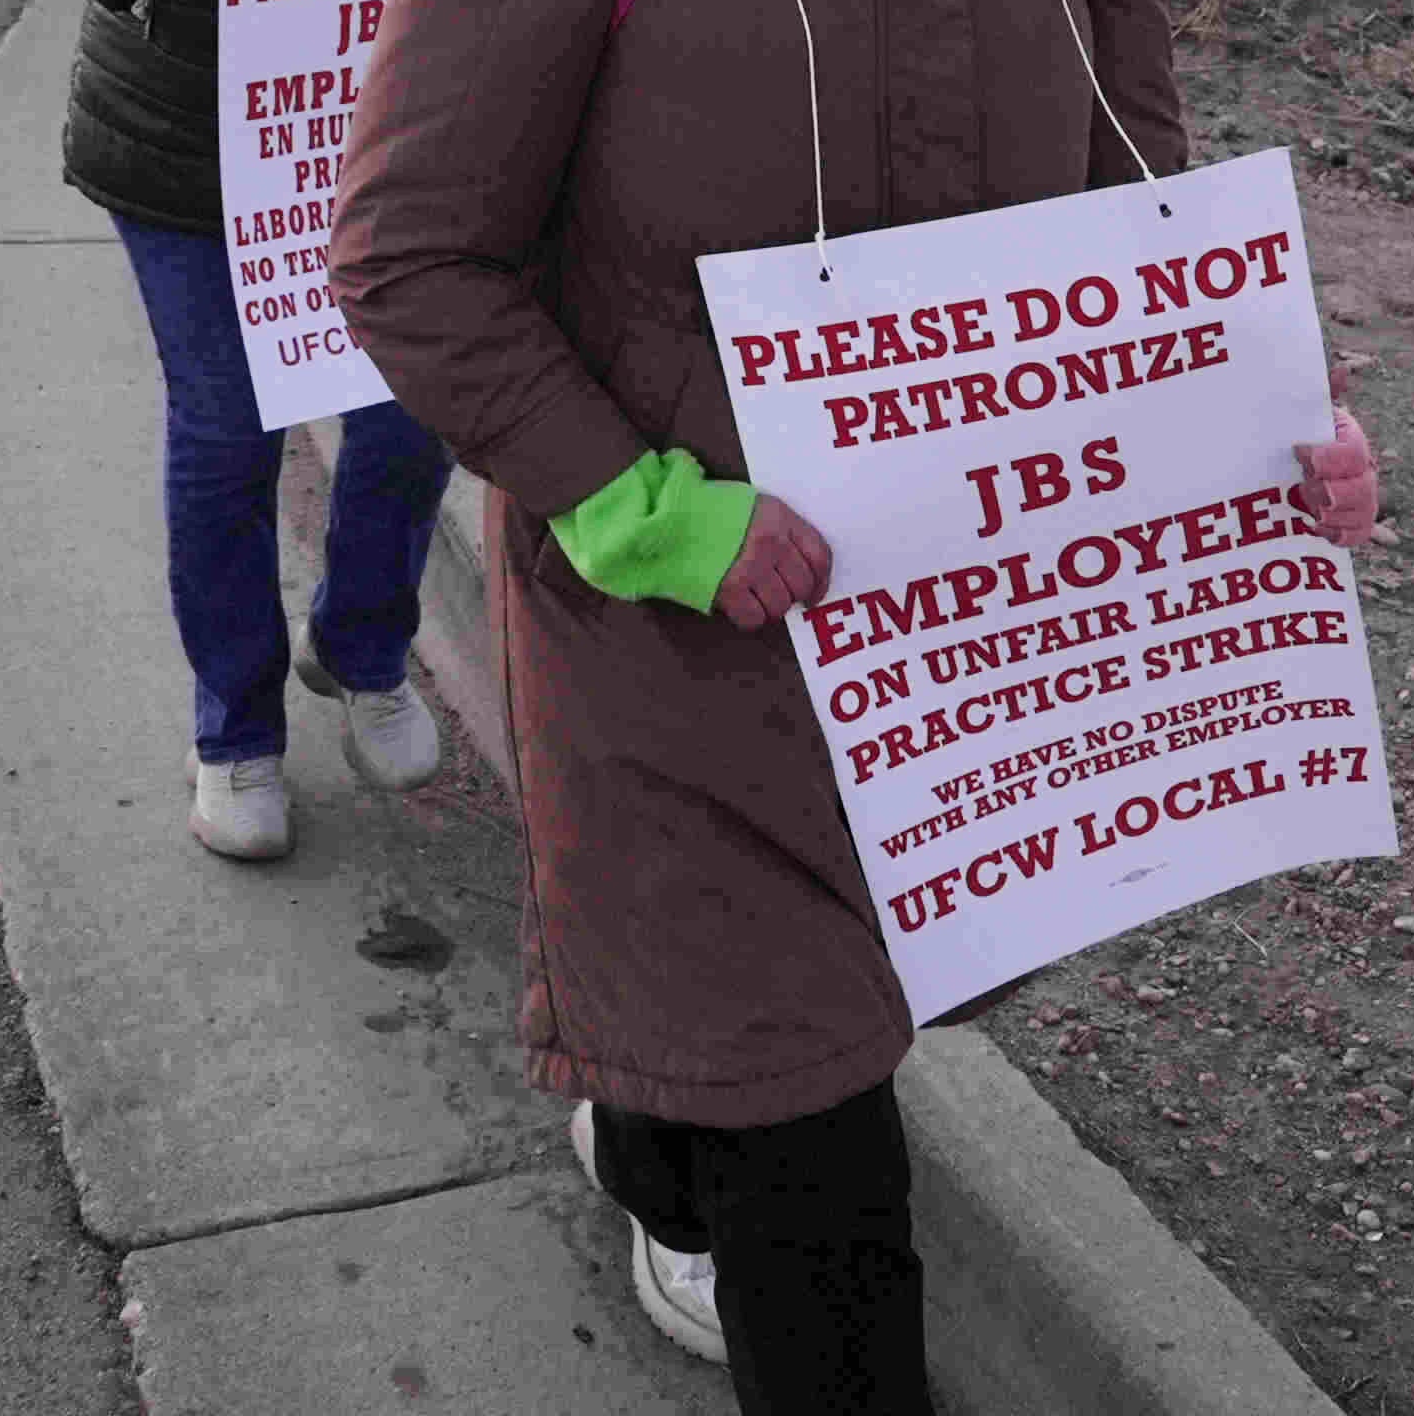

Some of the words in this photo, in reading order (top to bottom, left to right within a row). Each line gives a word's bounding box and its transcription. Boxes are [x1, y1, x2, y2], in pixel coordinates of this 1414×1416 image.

[259, 122, 294, 160] EN
[307, 111, 354, 150] HU
[239, 256, 276, 287] NO
[245, 291, 297, 326] CON
[731, 298, 996, 386] PLEASE
[1005, 275, 1119, 342] DO
[1136, 231, 1290, 316] NOT
[825, 322, 1229, 449] PATRONIZE
[967, 437, 1126, 539] JBS
[830, 660, 911, 723] ON
[922, 600, 1138, 685] UNFAIR
[1146, 555, 1345, 625] LABOR
[847, 655, 1131, 785] PRACTICE
[1143, 610, 1349, 681] STRIKE
[880, 805, 968, 859] WITH
[974, 776, 1038, 820] ANY
[1047, 739, 1161, 789] OTHER
[1165, 697, 1356, 753] EMPLOYER
[931, 769, 985, 805] WE
[989, 737, 1077, 784] HAVE
[1084, 720, 1134, 747] NO
[1141, 680, 1284, 734] DISPUTE
[889, 826, 1060, 933] UFCW
[1074, 760, 1285, 855] LOCAL
[1298, 746, 1368, 786] #7
